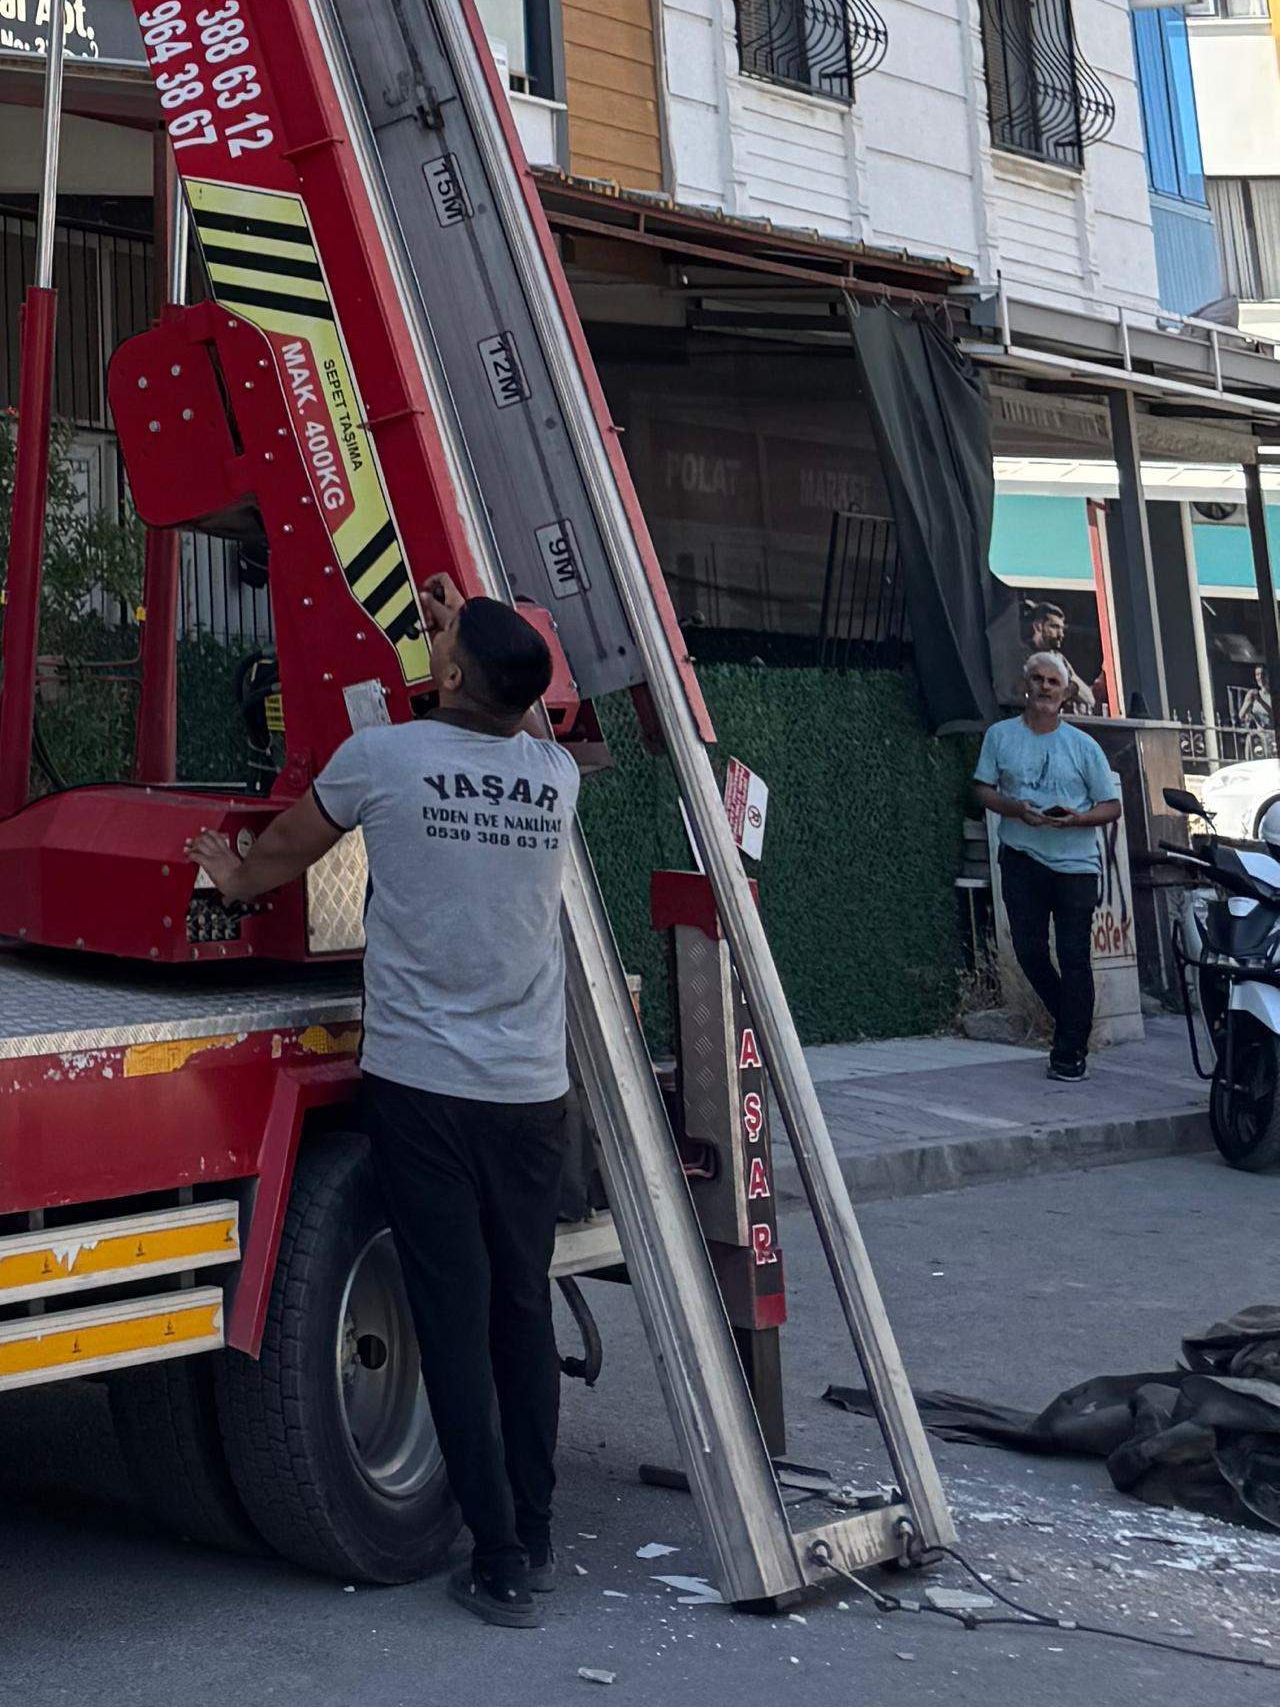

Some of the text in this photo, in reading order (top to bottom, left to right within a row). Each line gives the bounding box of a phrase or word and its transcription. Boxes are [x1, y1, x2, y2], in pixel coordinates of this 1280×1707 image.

[138, 0, 193, 65] 964
[196, 0, 250, 64] 388
[156, 63, 204, 109] 38
[211, 64, 262, 110] 63
[168, 109, 218, 150] 67
[224, 112, 274, 159] 12
[281, 341, 346, 511] MAK. 400KG
[323, 359, 364, 472] SEPET TAŞIMA
[423, 774, 559, 813] YAŞAR
[422, 806, 561, 833] EVDEN EVE NAKLİYAT
[426, 825, 559, 850] 0539 388 63 12
